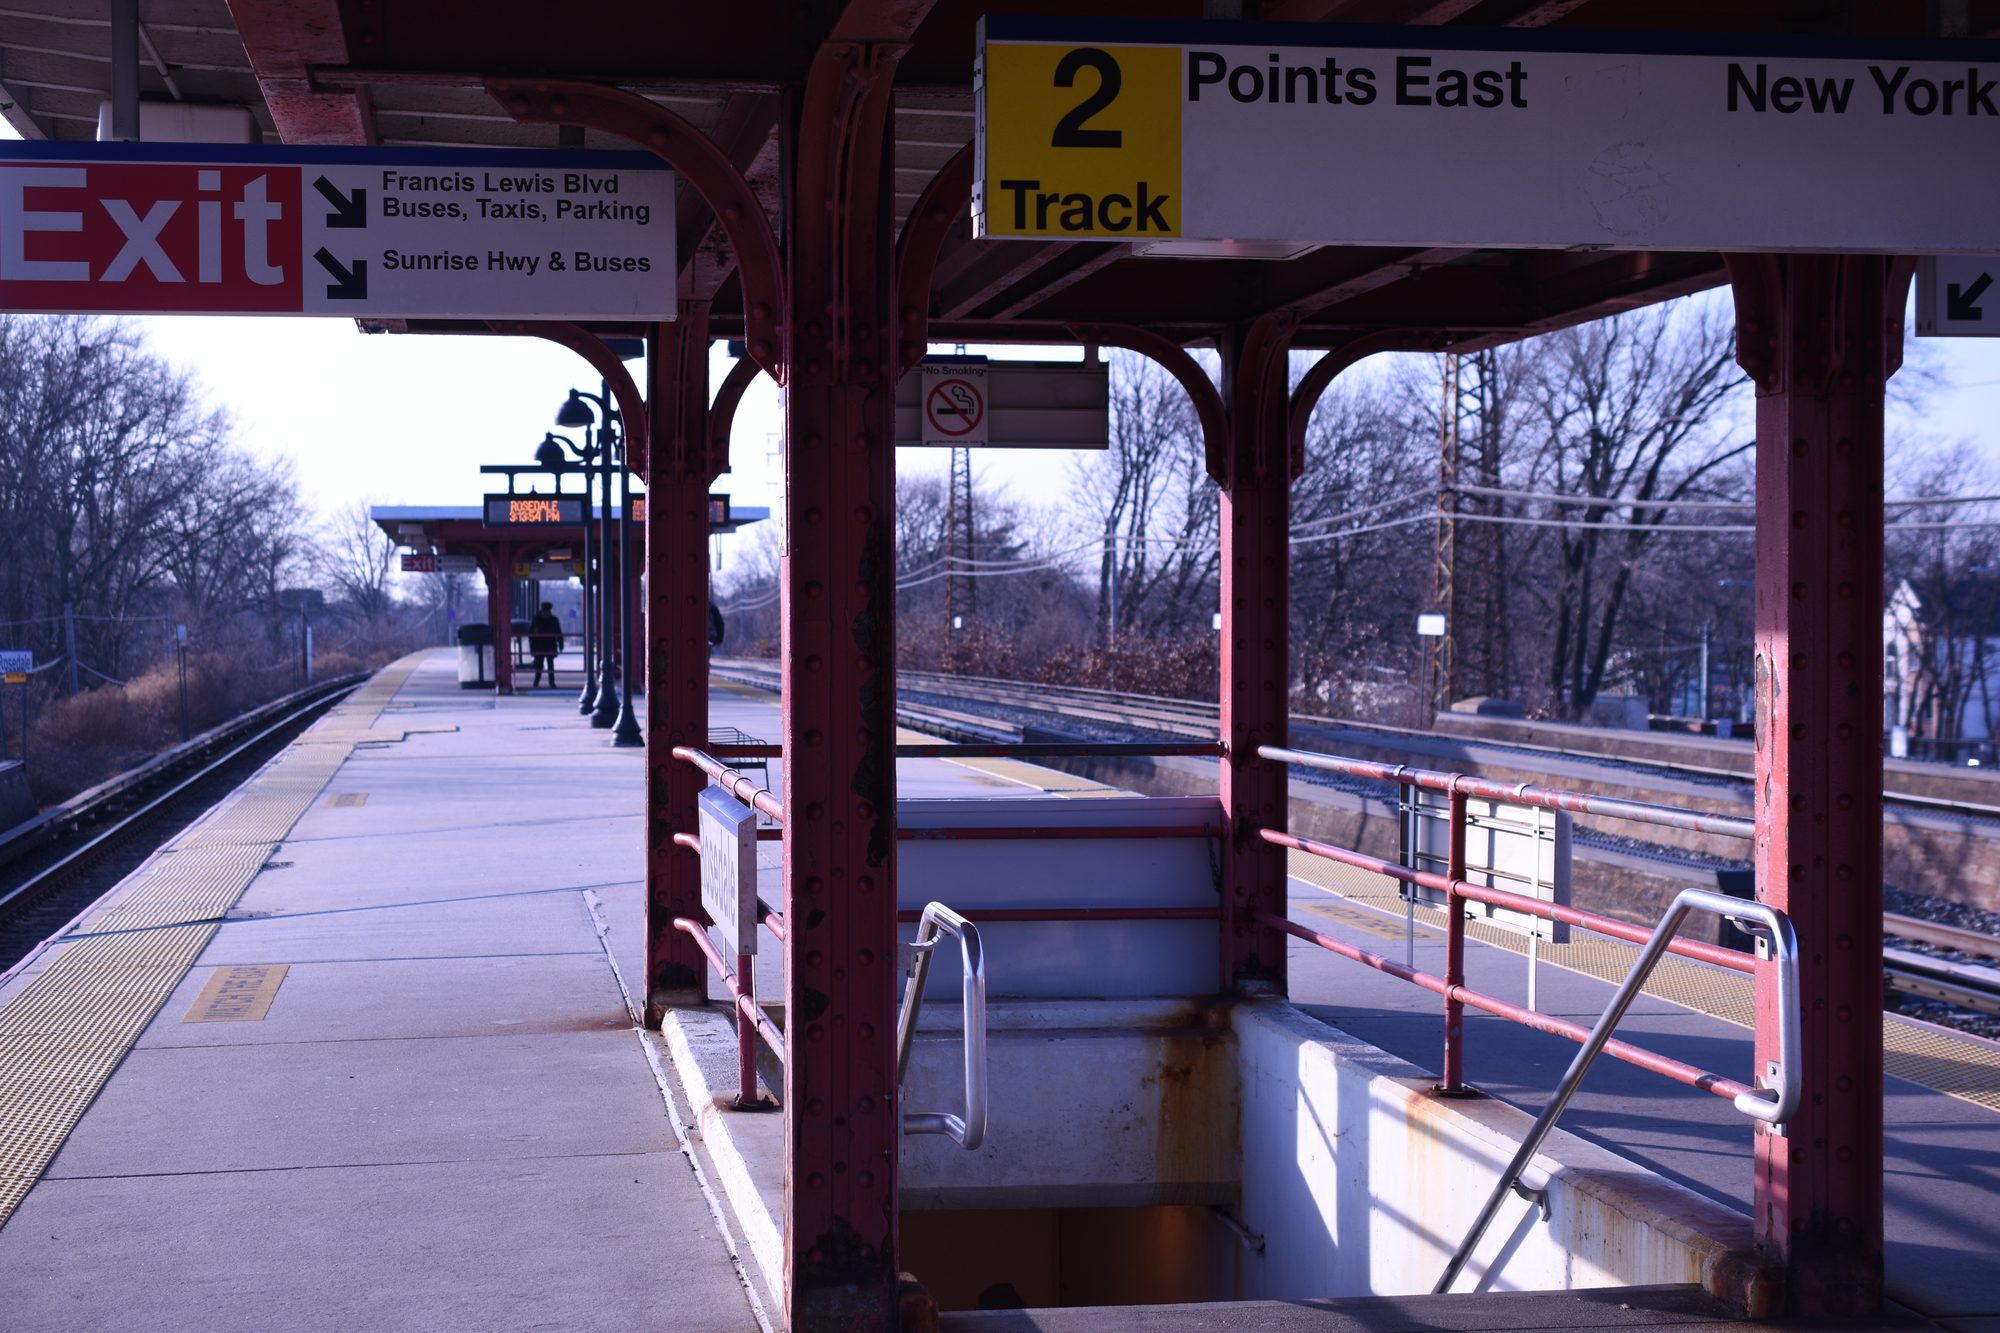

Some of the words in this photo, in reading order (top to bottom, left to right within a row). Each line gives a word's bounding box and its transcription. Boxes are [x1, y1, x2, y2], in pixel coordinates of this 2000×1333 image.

[1188, 51, 1377, 105] Points
[1395, 55, 1527, 109] East
[1727, 63, 1855, 114] New
[1867, 65, 2000, 117] York
[1051, 47, 1123, 149] 2
[382, 171, 475, 193] Francis
[484, 172, 555, 194] Lewis
[563, 173, 619, 195] Blvd
[383, 197, 469, 221] Buses,
[475, 198, 547, 223] Taxis,
[556, 199, 650, 226] Parking
[999, 179, 1172, 232] Track
[0, 166, 285, 286] Exit
[382, 249, 479, 271] Sunrise
[487, 250, 541, 276] Hwy
[548, 252, 567, 272] &
[574, 252, 651, 272] Buses
[926, 366, 940, 375] No
[942, 366, 984, 377] Smoking
[510, 500, 559, 511] ROSEDALE
[546, 510, 561, 523] PM
[403, 556, 433, 570] Exit
